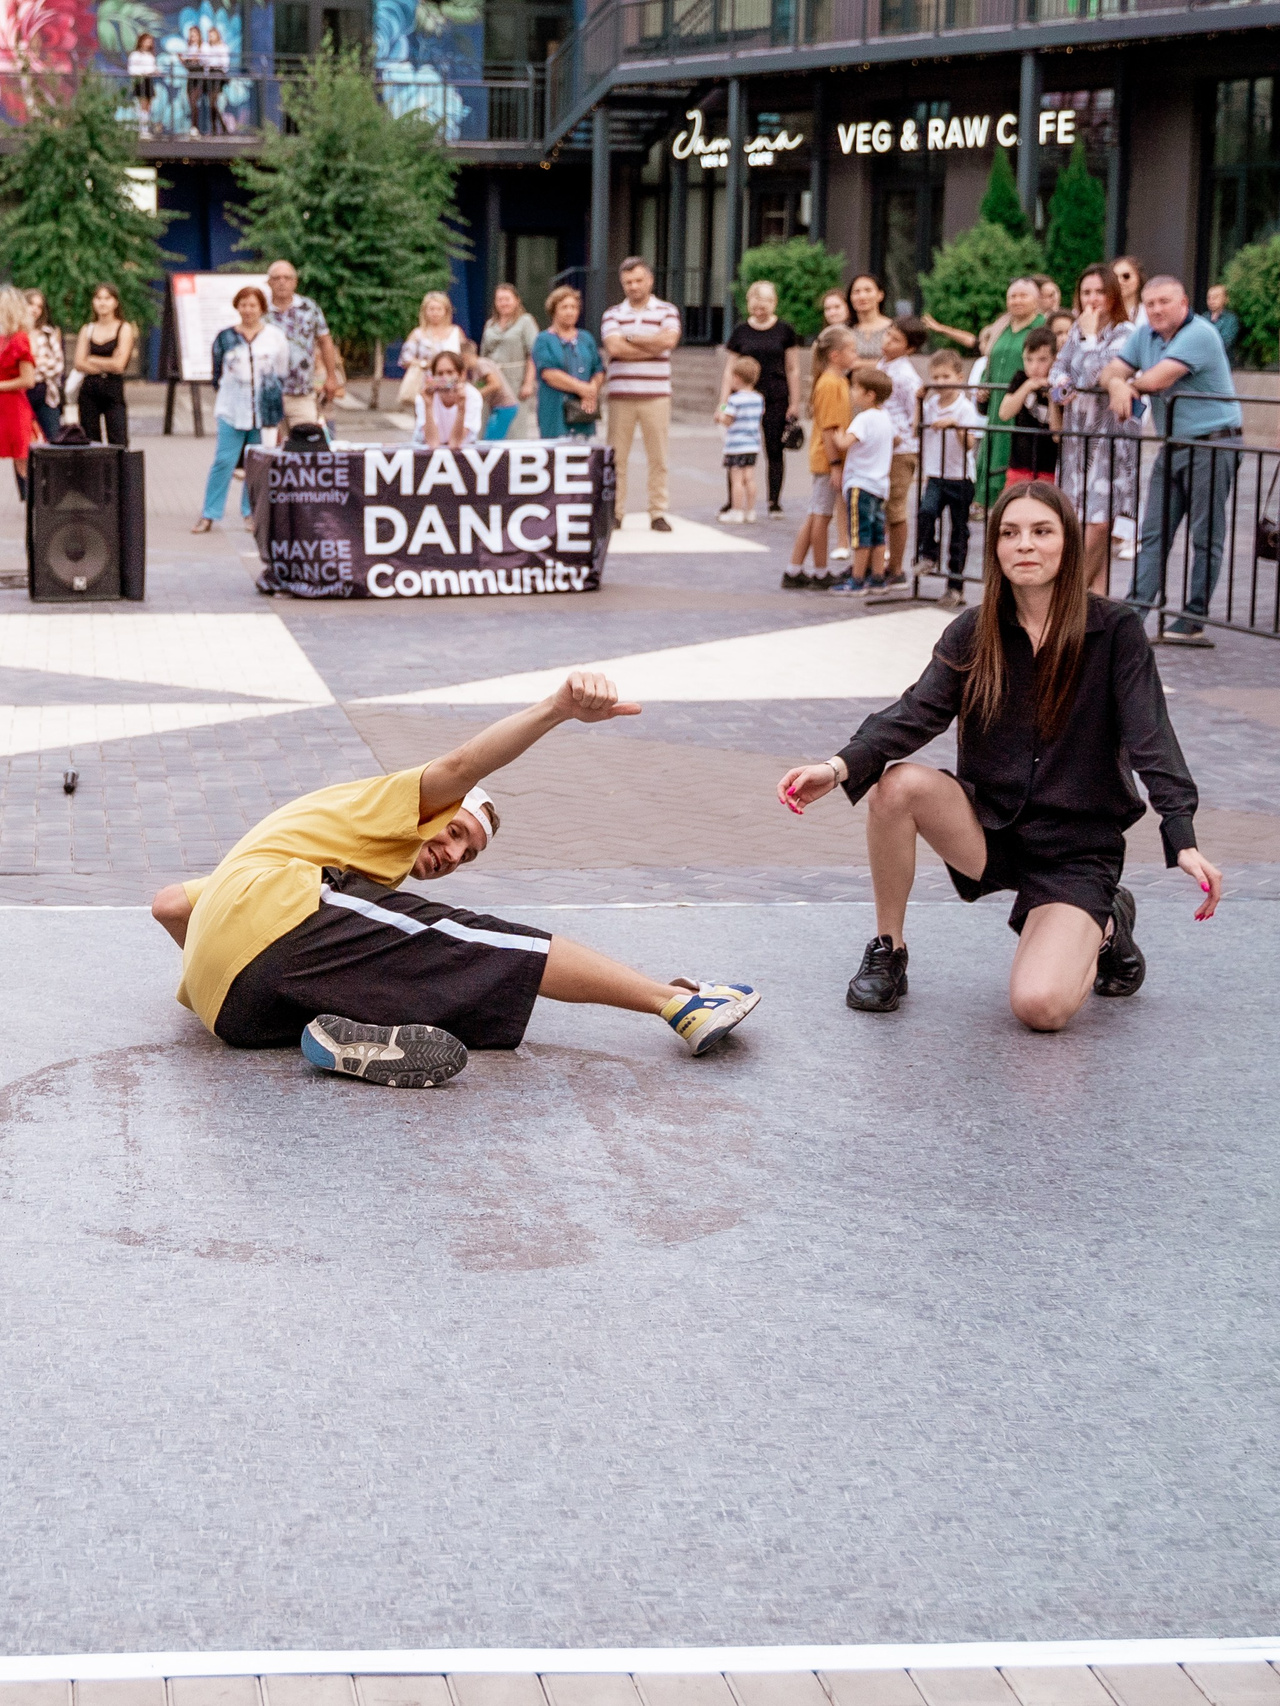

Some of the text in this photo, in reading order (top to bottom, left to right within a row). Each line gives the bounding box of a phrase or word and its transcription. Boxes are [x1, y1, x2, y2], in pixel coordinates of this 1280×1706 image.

[837, 110, 1076, 154] VEG & RAW CFE
[268, 468, 349, 487] DANCE
[364, 448, 593, 496] MAYBE
[269, 489, 349, 506] Community
[364, 503, 593, 555] DANCE
[271, 539, 351, 560] MAYBE
[273, 561, 353, 581] DANCE
[367, 560, 589, 598] Community
